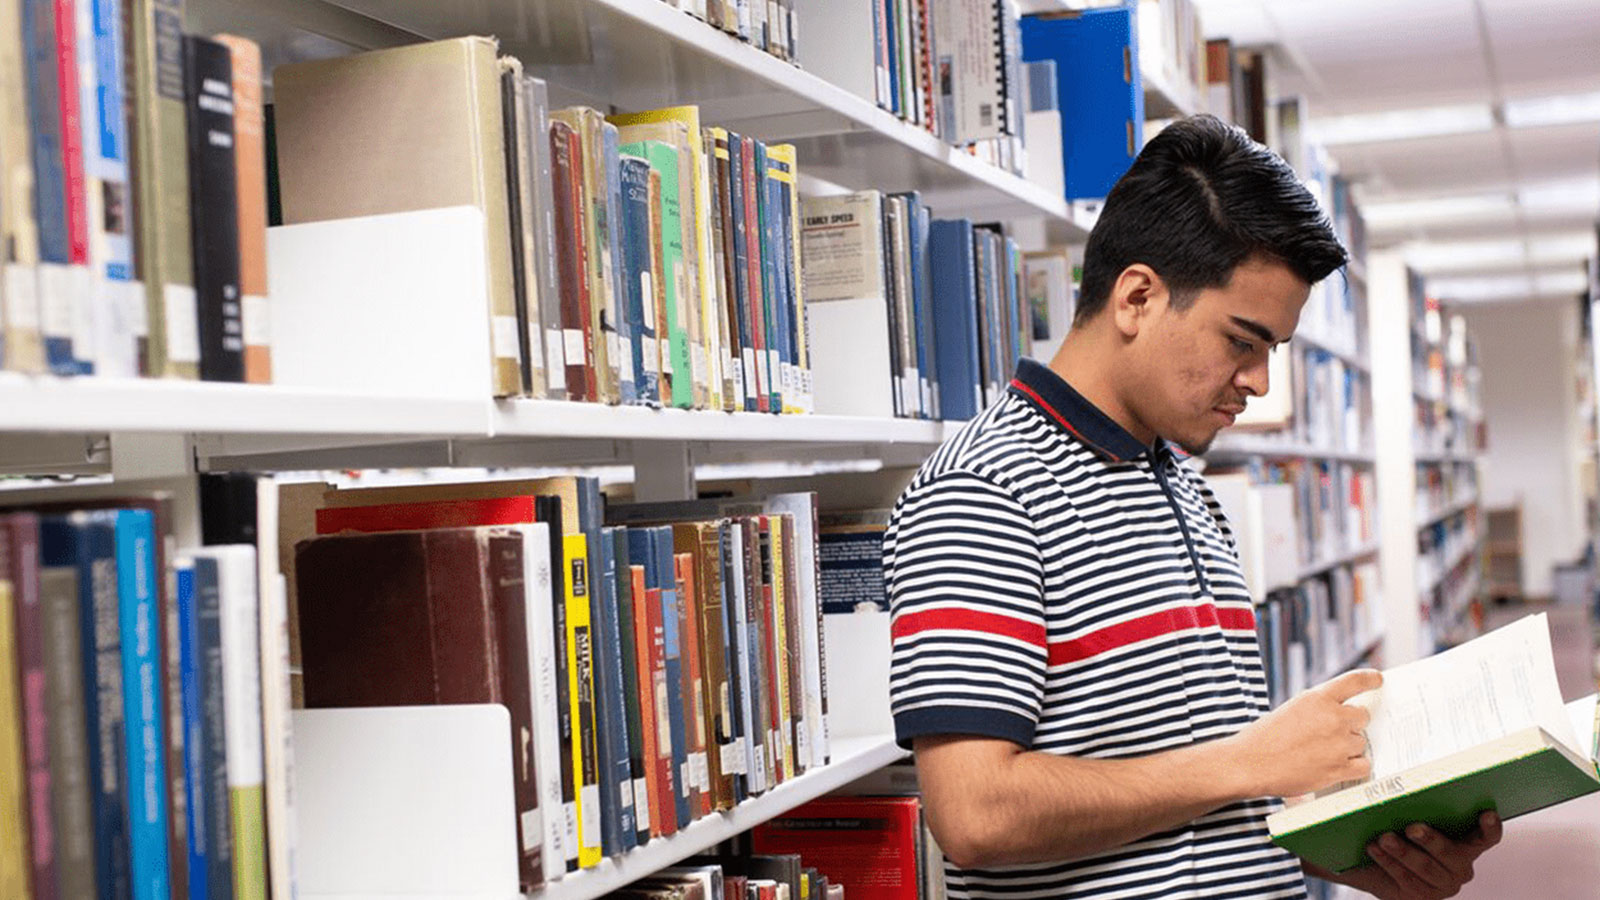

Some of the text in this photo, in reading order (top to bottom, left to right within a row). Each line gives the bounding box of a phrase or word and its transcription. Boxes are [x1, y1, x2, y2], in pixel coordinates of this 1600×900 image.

[806, 213, 854, 225] EARLY SPEED
[581, 632, 590, 680] MILK
